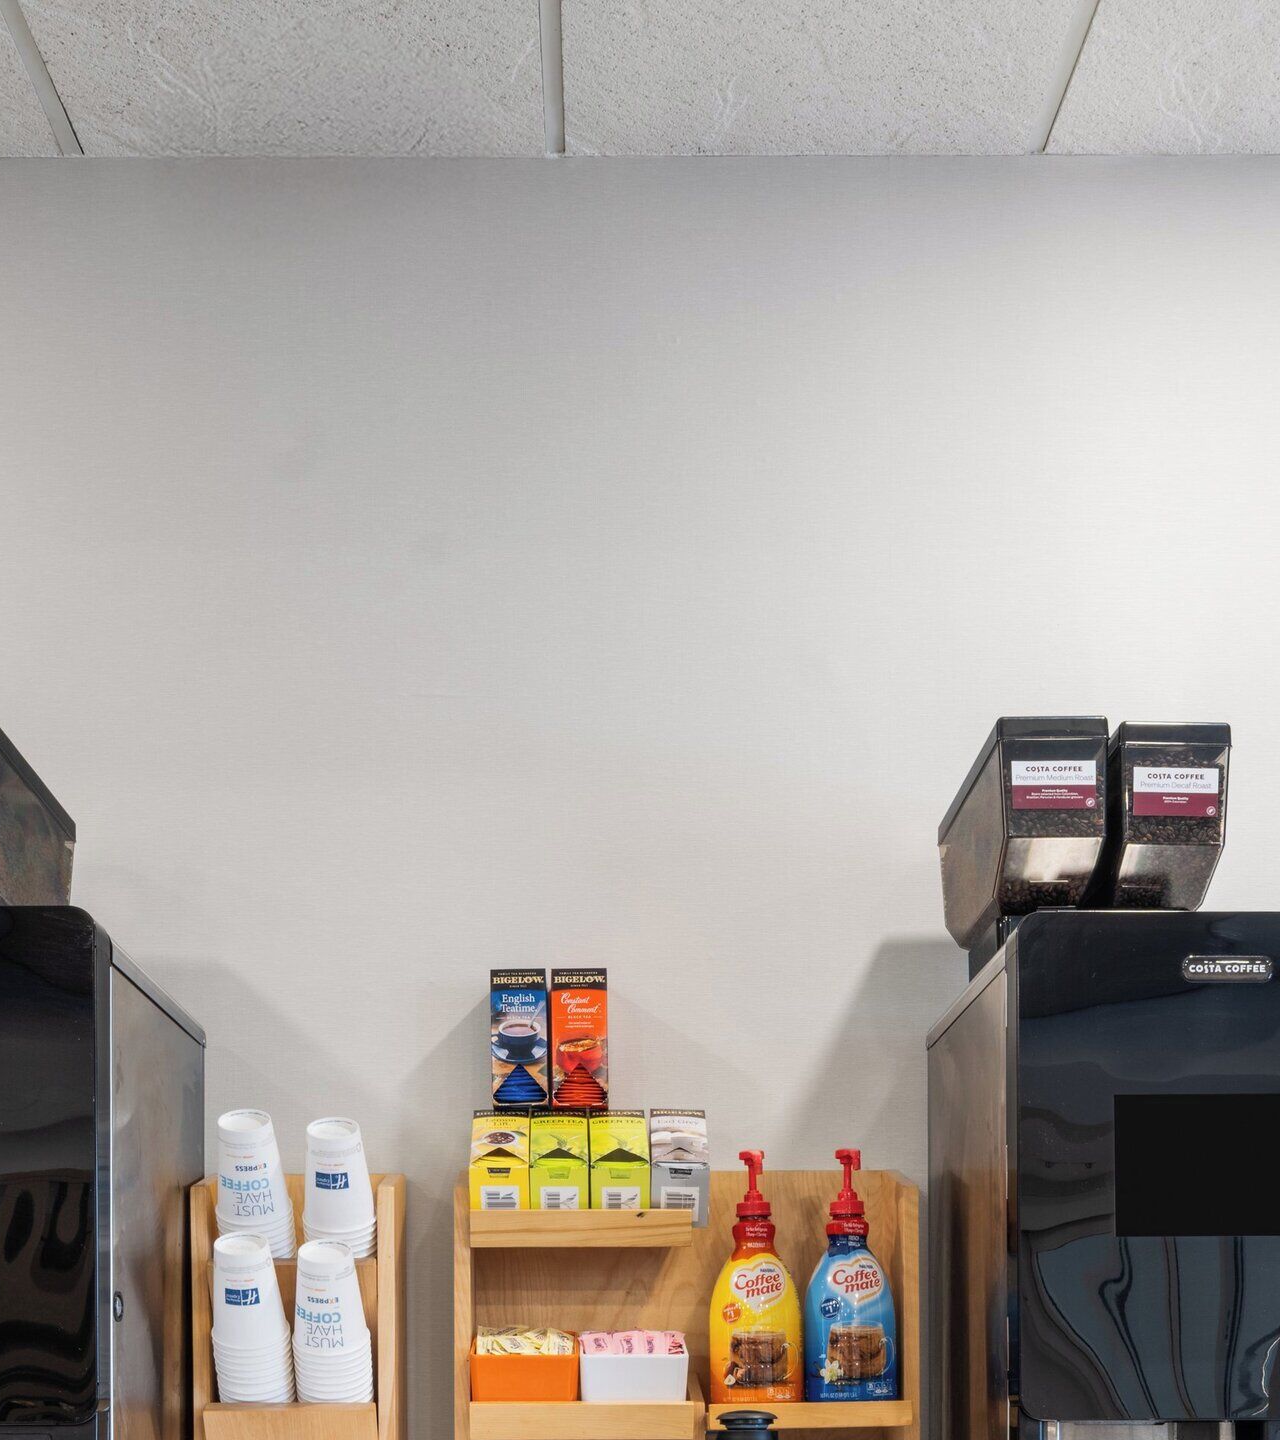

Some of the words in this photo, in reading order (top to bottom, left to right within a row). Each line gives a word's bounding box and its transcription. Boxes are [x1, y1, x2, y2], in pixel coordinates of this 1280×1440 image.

[1140, 781, 1170, 789] Premium
[1189, 964, 1222, 974] COSTA
[1225, 964, 1266, 973] COFFEE
[492, 976, 544, 984] BIGELOW
[553, 975, 606, 984] BIGELOW
[502, 993, 535, 1006] English
[560, 992, 590, 1005] Constant
[500, 1003, 537, 1013] Teatime
[235, 1162, 267, 1172] EXPRESS
[219, 1174, 270, 1192] COFFEE
[734, 1273, 780, 1290] Coffee
[832, 1269, 878, 1285] Coffee
[746, 1282, 782, 1298] mate
[844, 1278, 880, 1294] mate
[307, 1296, 339, 1305] EXPRESS
